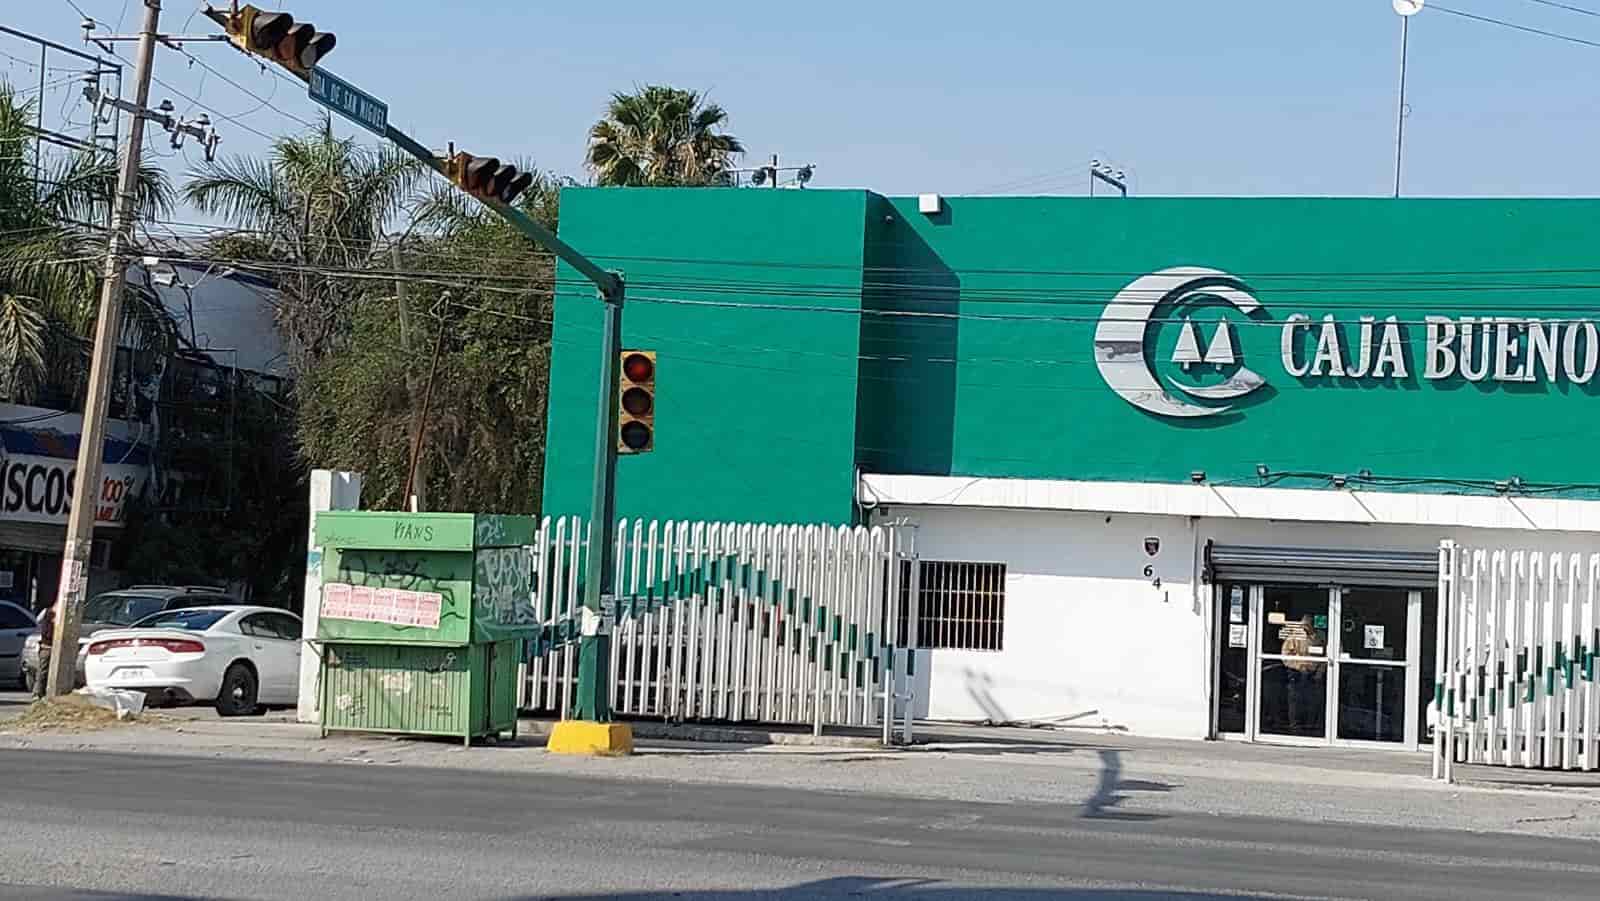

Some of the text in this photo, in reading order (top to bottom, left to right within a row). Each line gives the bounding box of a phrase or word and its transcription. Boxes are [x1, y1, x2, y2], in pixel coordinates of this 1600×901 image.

[330, 83, 340, 105] DE
[343, 90, 358, 113] SAN
[360, 95, 385, 129] MIGUEL
[1280, 313, 1599, 384] CAJA BUENO
